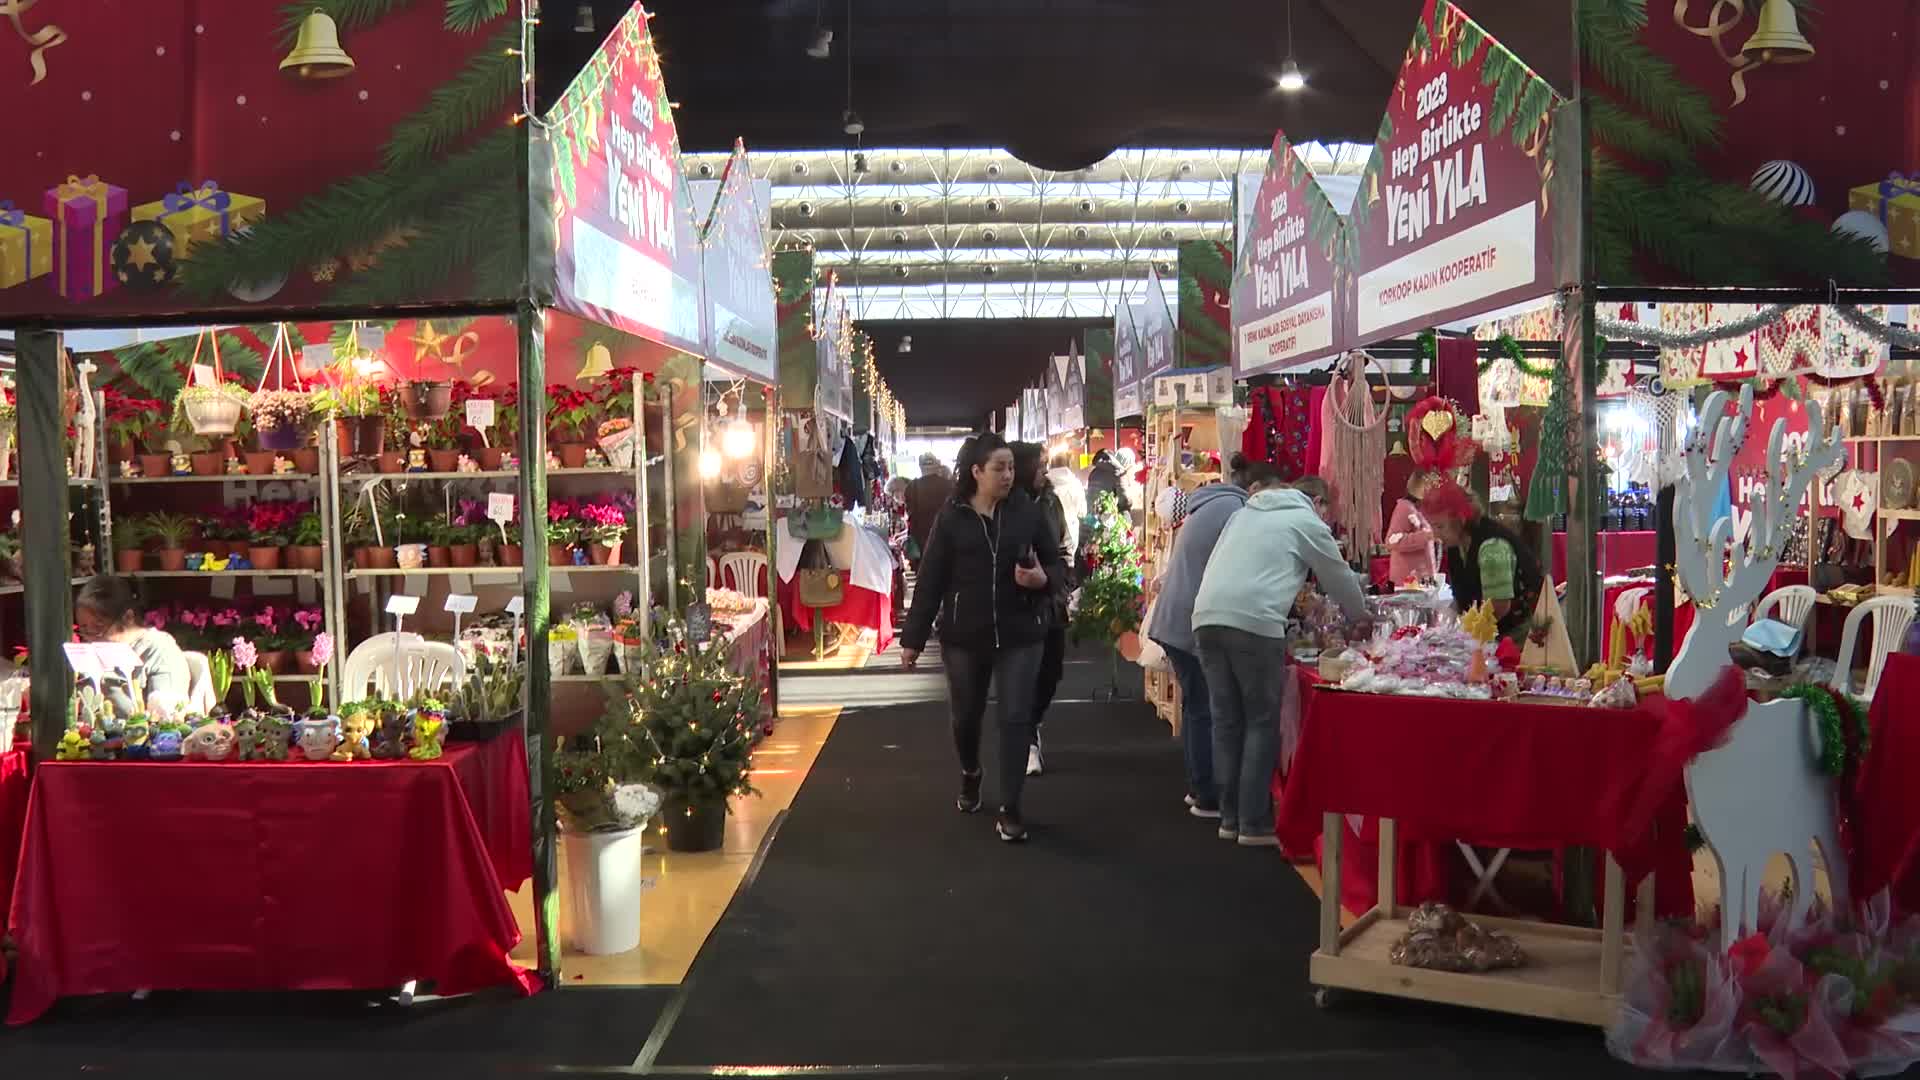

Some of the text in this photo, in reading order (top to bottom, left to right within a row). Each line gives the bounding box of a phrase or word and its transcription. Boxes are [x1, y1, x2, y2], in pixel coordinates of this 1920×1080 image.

[631, 83, 654, 131] 2023
[1416, 71, 1448, 121] 2023
[611, 110, 673, 193] Hep Birlikte
[1391, 102, 1482, 180] Hep Birlikte
[1270, 191, 1288, 221] 2023
[1431, 143, 1488, 226] YILA
[644, 175, 678, 262] YILA
[1257, 215, 1306, 260] Hep Birlikte
[1280, 244, 1310, 300] YILA
[1412, 268, 1438, 293] KADIN
[1438, 244, 1498, 286] KOOPERATİF
[1280, 314, 1298, 333] SOSYAL
